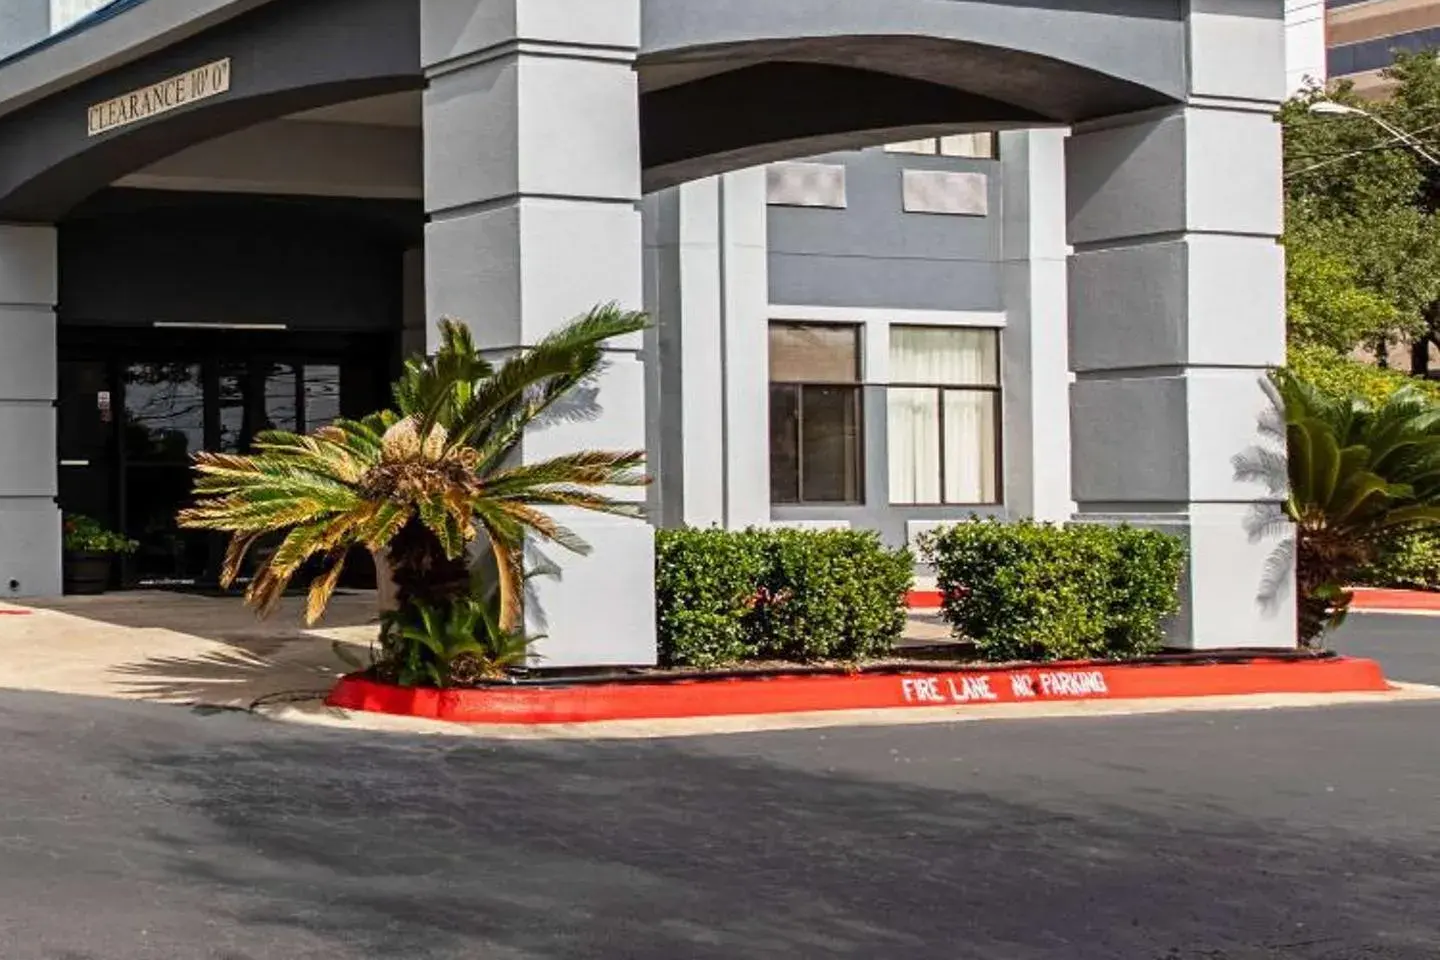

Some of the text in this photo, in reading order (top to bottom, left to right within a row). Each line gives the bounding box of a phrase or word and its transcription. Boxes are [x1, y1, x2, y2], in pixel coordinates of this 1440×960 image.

[89, 78, 186, 132] CLEARANCE
[901, 671, 1108, 702] FIRE LANE NO PARKING
